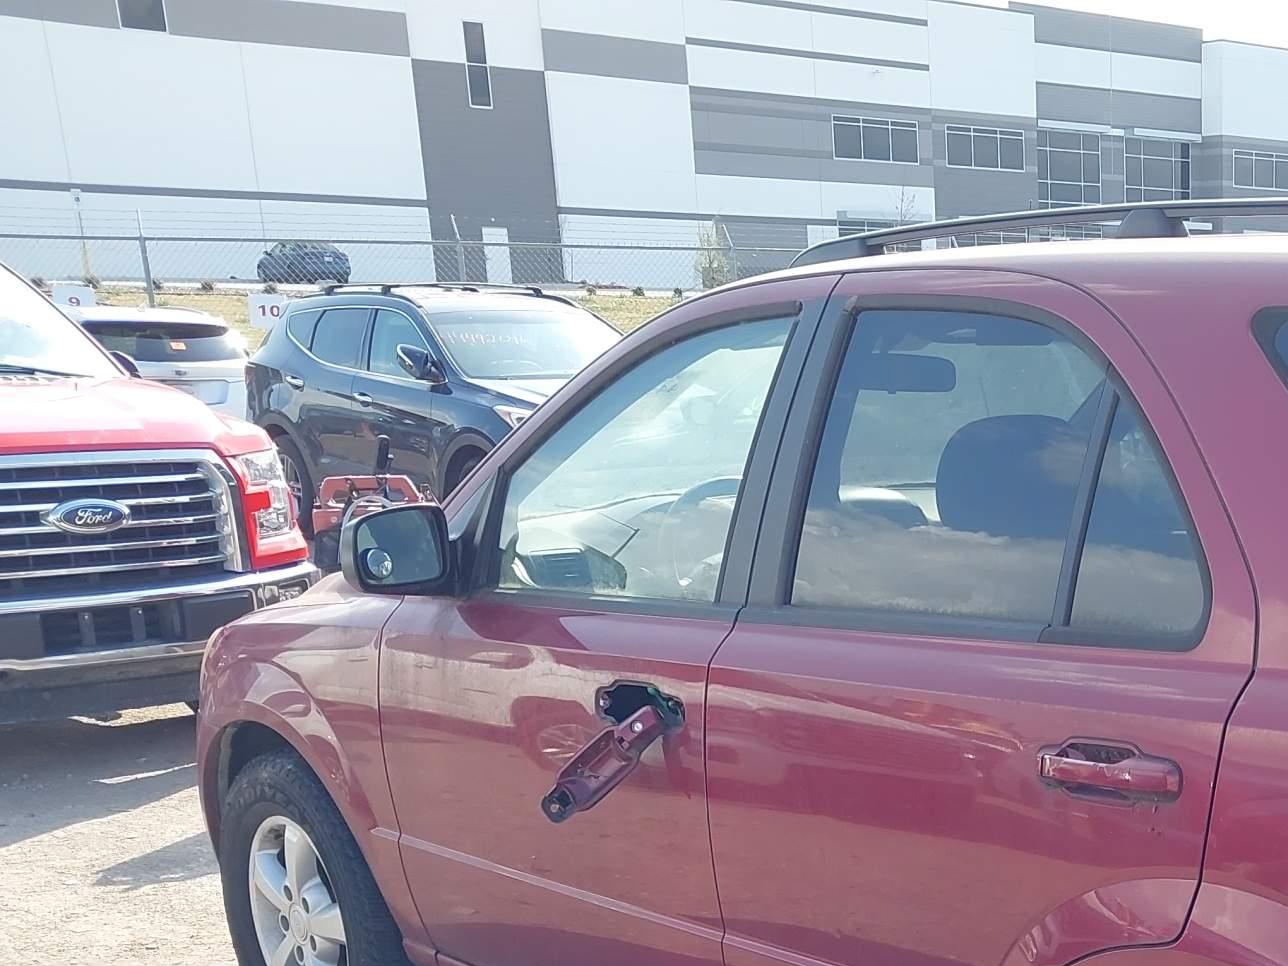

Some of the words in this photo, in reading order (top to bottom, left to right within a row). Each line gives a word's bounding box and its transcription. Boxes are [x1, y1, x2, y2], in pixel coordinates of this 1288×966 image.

[68, 297, 81, 307] 9
[258, 304, 280, 317] 10
[75, 508, 113, 524] Ford
